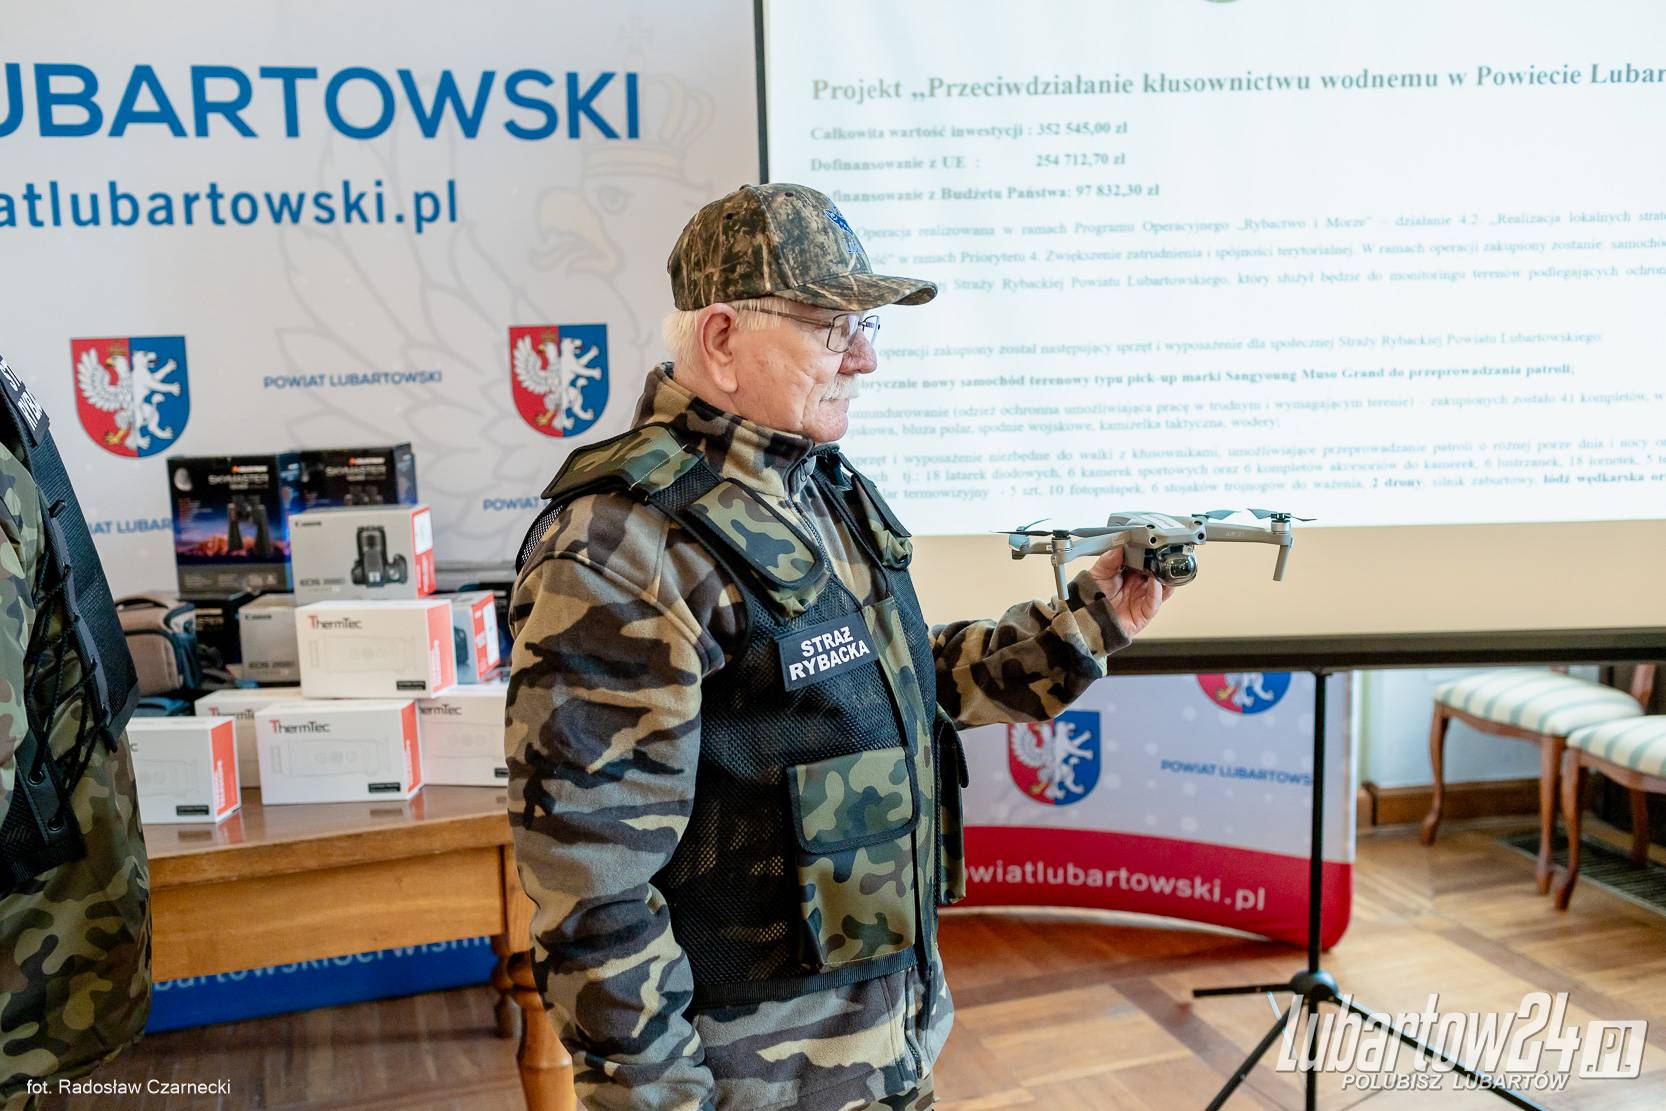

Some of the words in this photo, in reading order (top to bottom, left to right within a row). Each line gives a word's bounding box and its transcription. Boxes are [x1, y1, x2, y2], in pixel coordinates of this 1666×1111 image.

[812, 79, 902, 103] Projekt
[1143, 71, 1310, 93] kłusownictwu
[1320, 69, 1439, 89] wodnemu
[1447, 71, 1467, 86] w
[1476, 66, 1581, 86] Powiecie
[832, 189, 924, 203] finansowanie
[263, 373, 326, 389] POWIAT
[330, 371, 442, 387] LUBARTOWSKI
[482, 496, 540, 511] POWIAT
[307, 614, 363, 630] ThermTec
[788, 640, 870, 681] RYBACKA
[419, 704, 463, 716] ermTec
[269, 719, 331, 734] ThermTec
[1160, 758, 1217, 775] POWIAT
[1219, 765, 1314, 786] LUBARTOWS
[964, 859, 1266, 911] wiatlubartowski.pl
